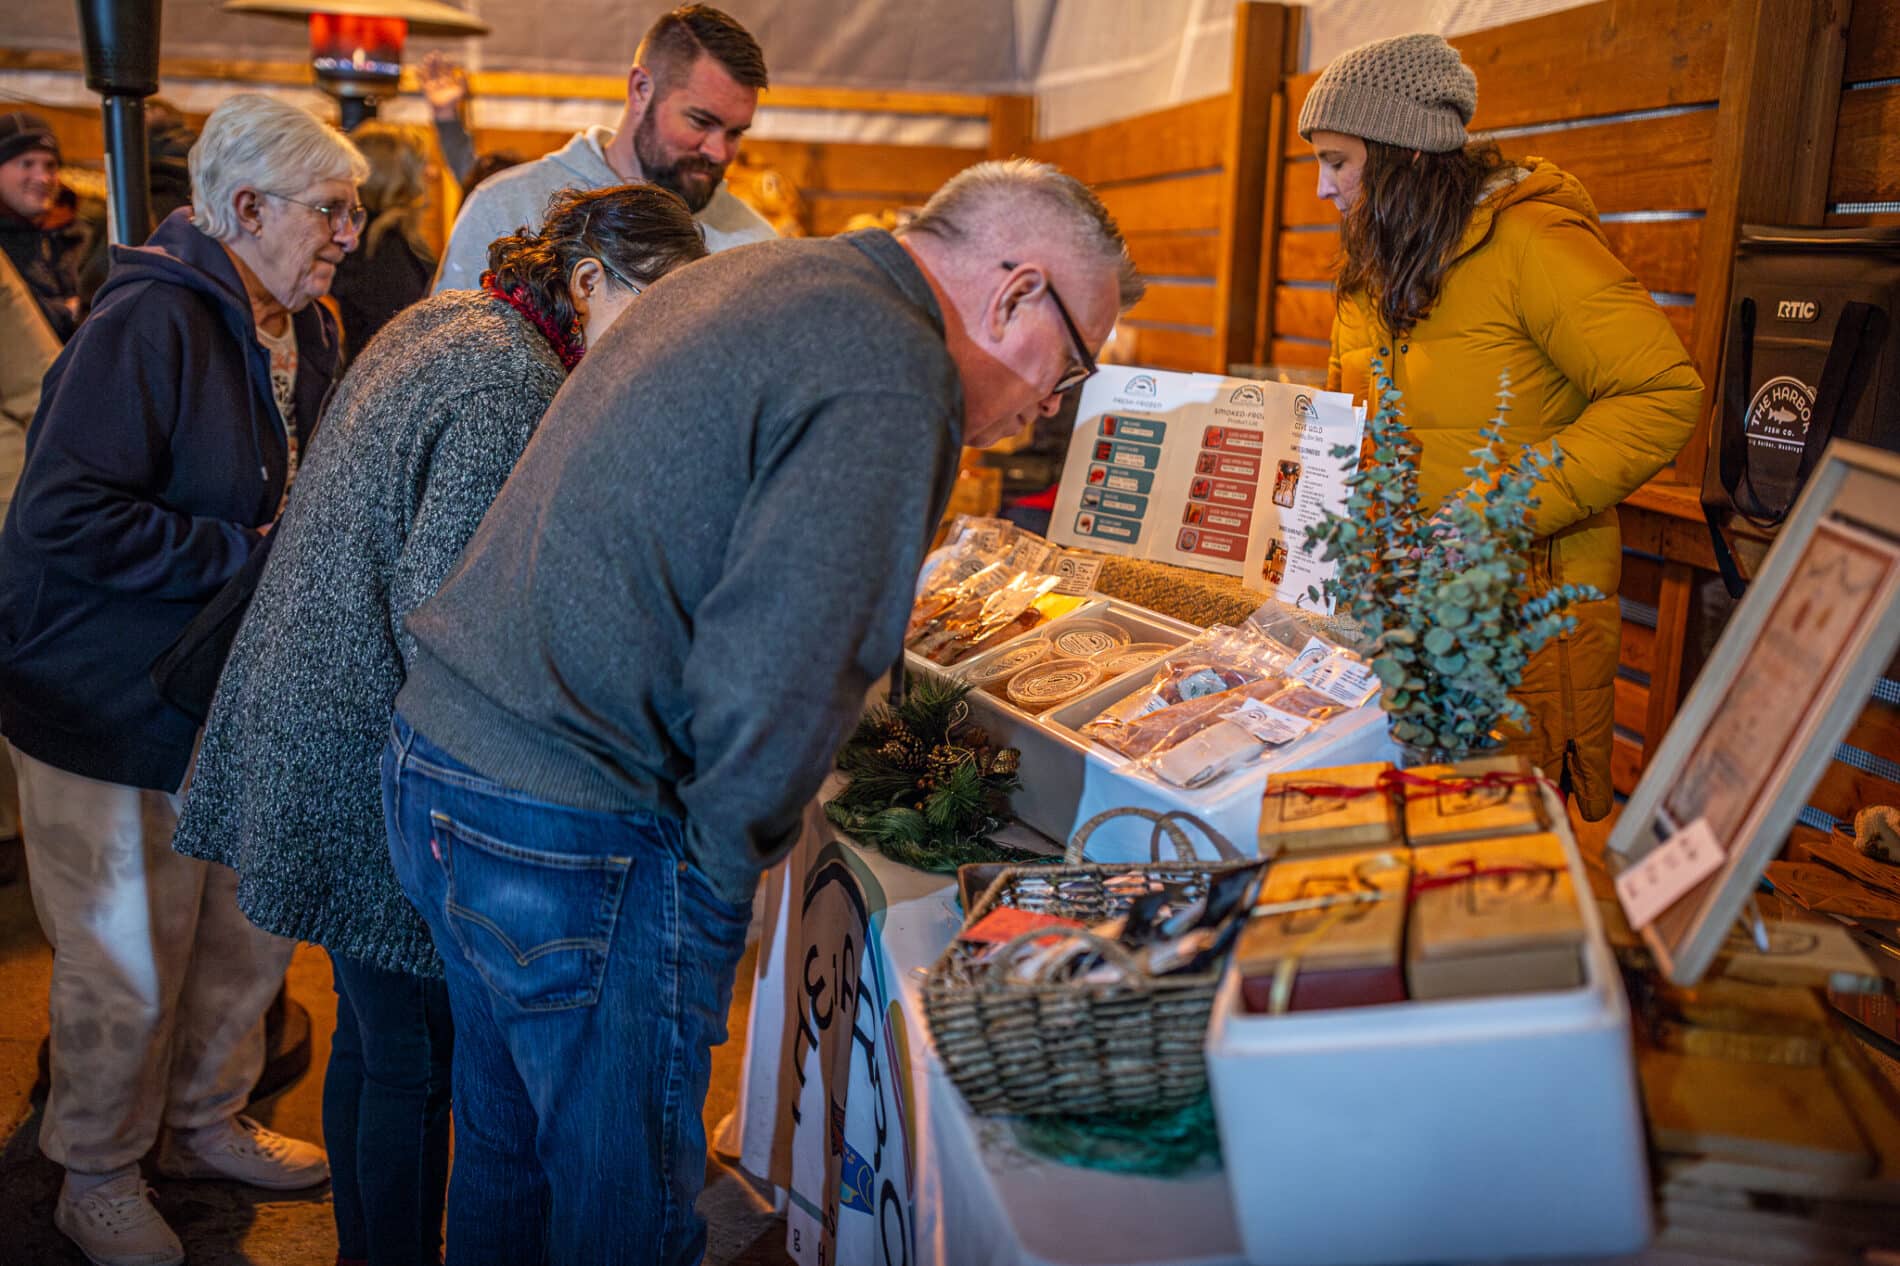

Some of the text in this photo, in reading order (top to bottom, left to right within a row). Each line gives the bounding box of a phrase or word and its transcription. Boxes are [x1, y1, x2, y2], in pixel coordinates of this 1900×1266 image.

[1777, 300, 1815, 319] RTIC
[1214, 408, 1264, 420] SMOKED-FRO
[1751, 394, 1771, 426] THE
